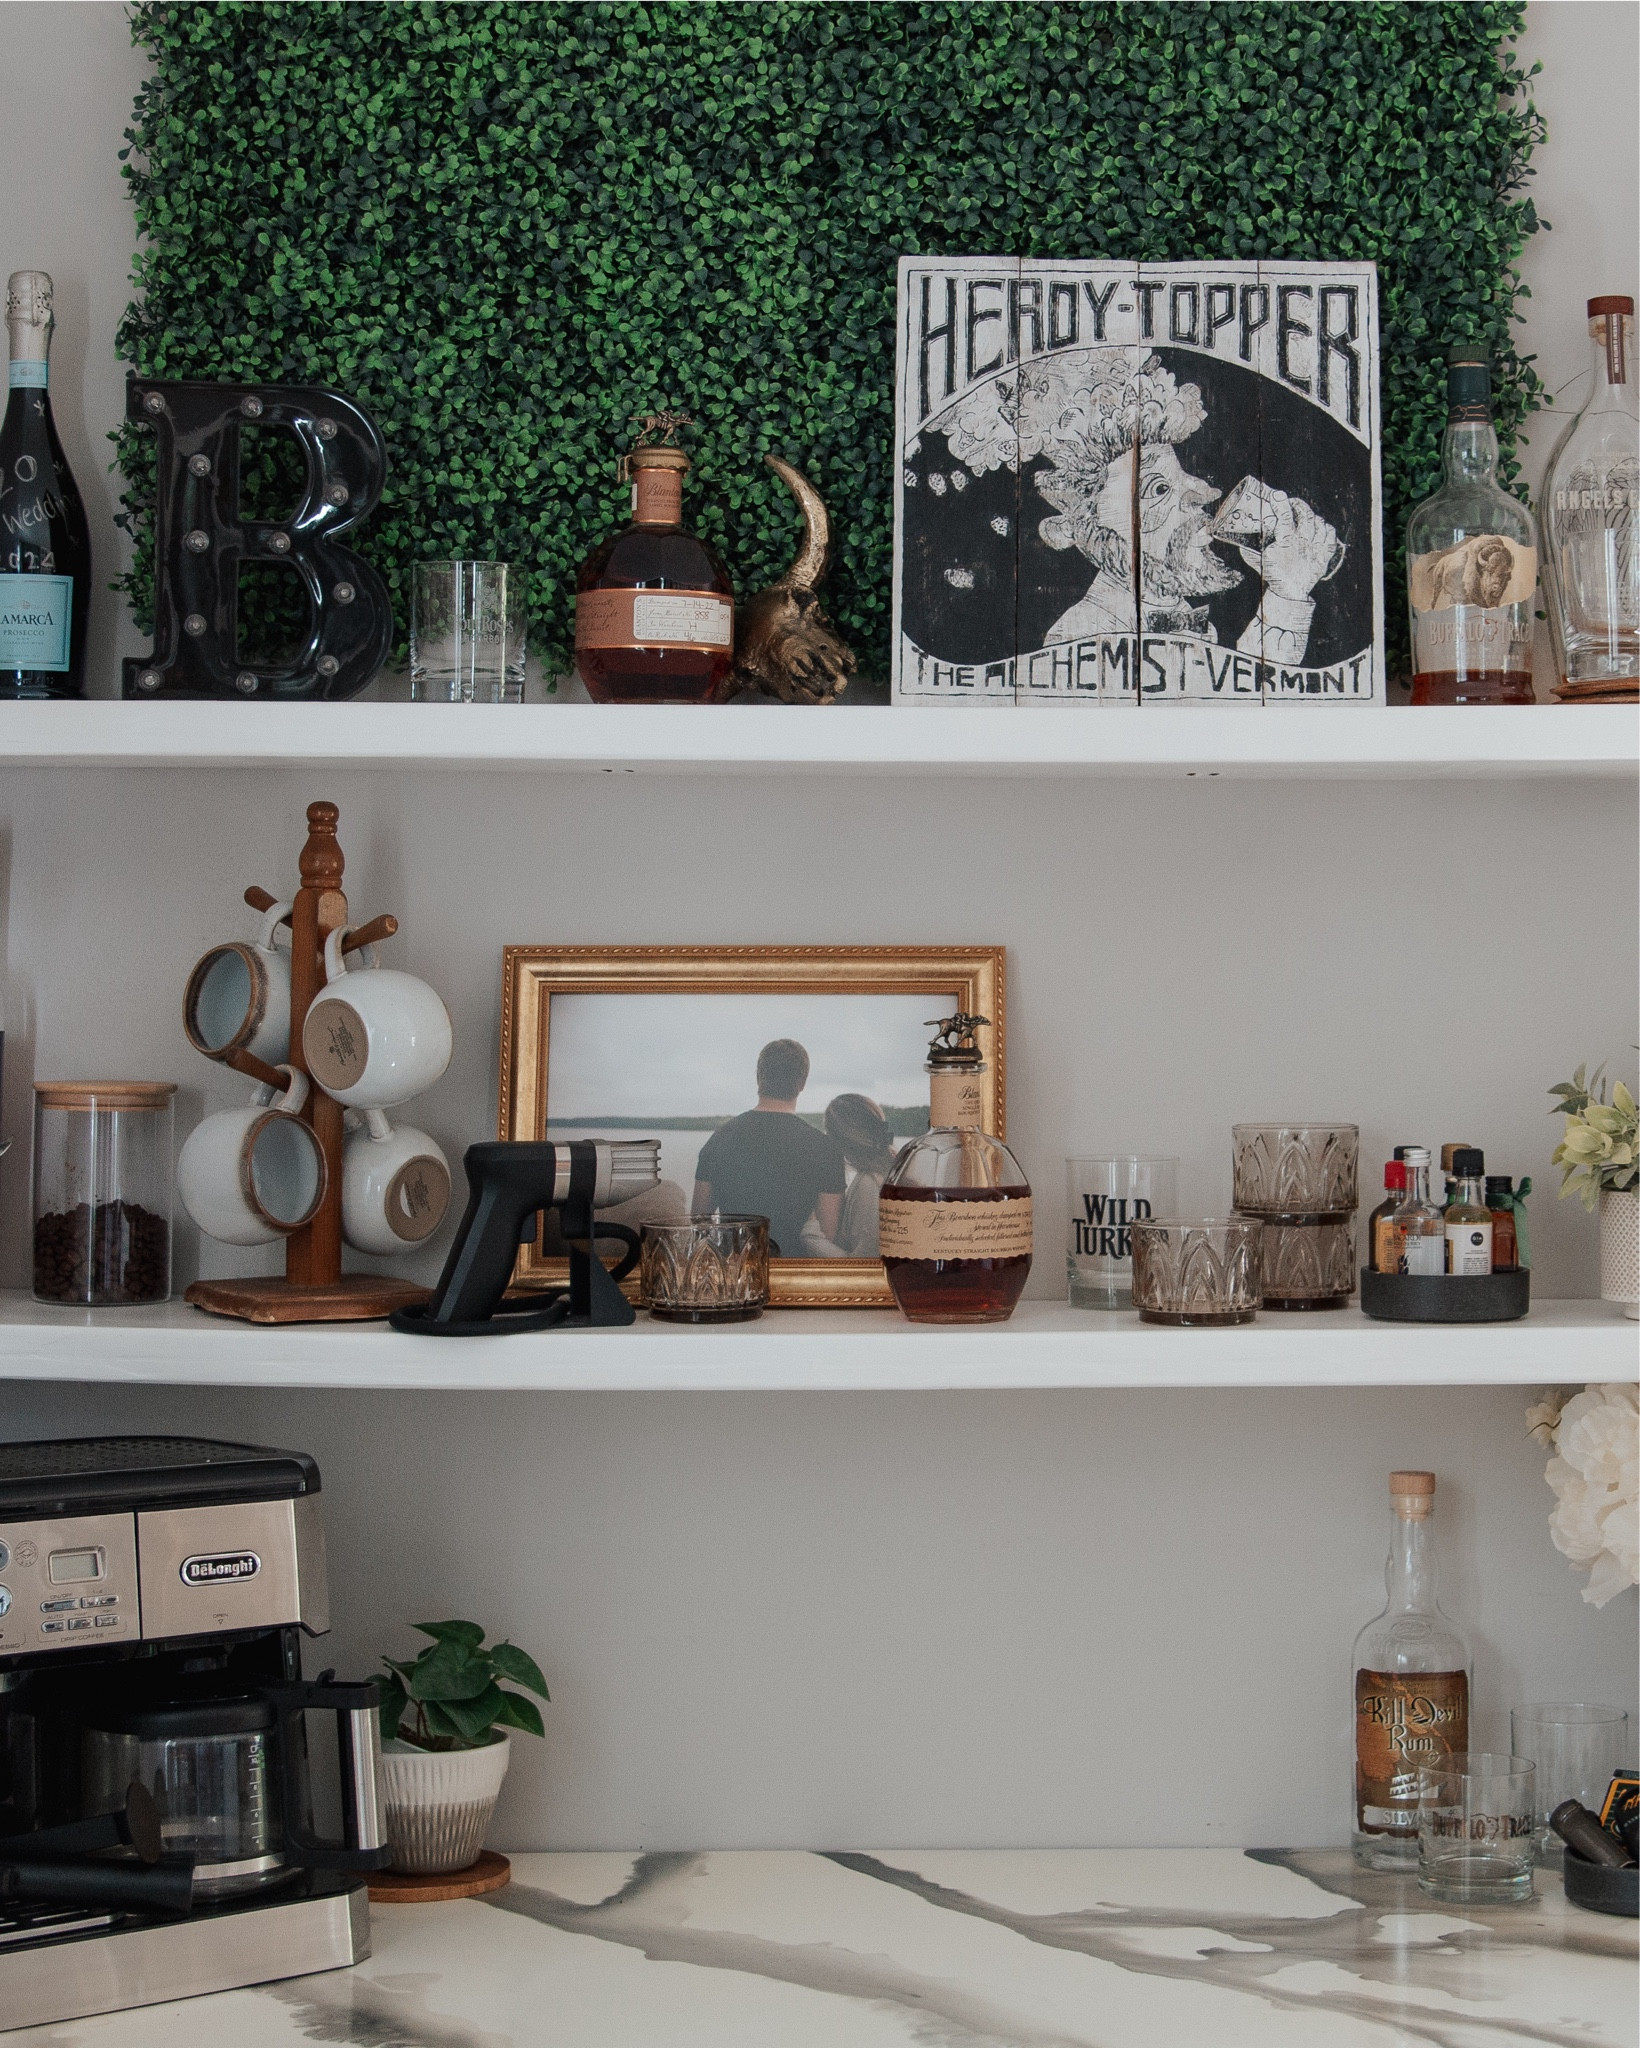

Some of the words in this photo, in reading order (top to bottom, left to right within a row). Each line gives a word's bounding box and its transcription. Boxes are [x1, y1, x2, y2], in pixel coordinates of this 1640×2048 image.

[122, 379, 393, 700] B
[3, 629, 45, 637] PROSECCO
[1429, 620, 1485, 646] BUFLO
[911, 646, 976, 688] THE
[1082, 1193, 1152, 1226] WILD
[1072, 1218, 1133, 1260] TURK
[1363, 1695, 1405, 1728] Kill
[1411, 1696, 1463, 1725] Devil
[1385, 1724, 1437, 1757] Rum
[1382, 1810, 1418, 1826] SILV
